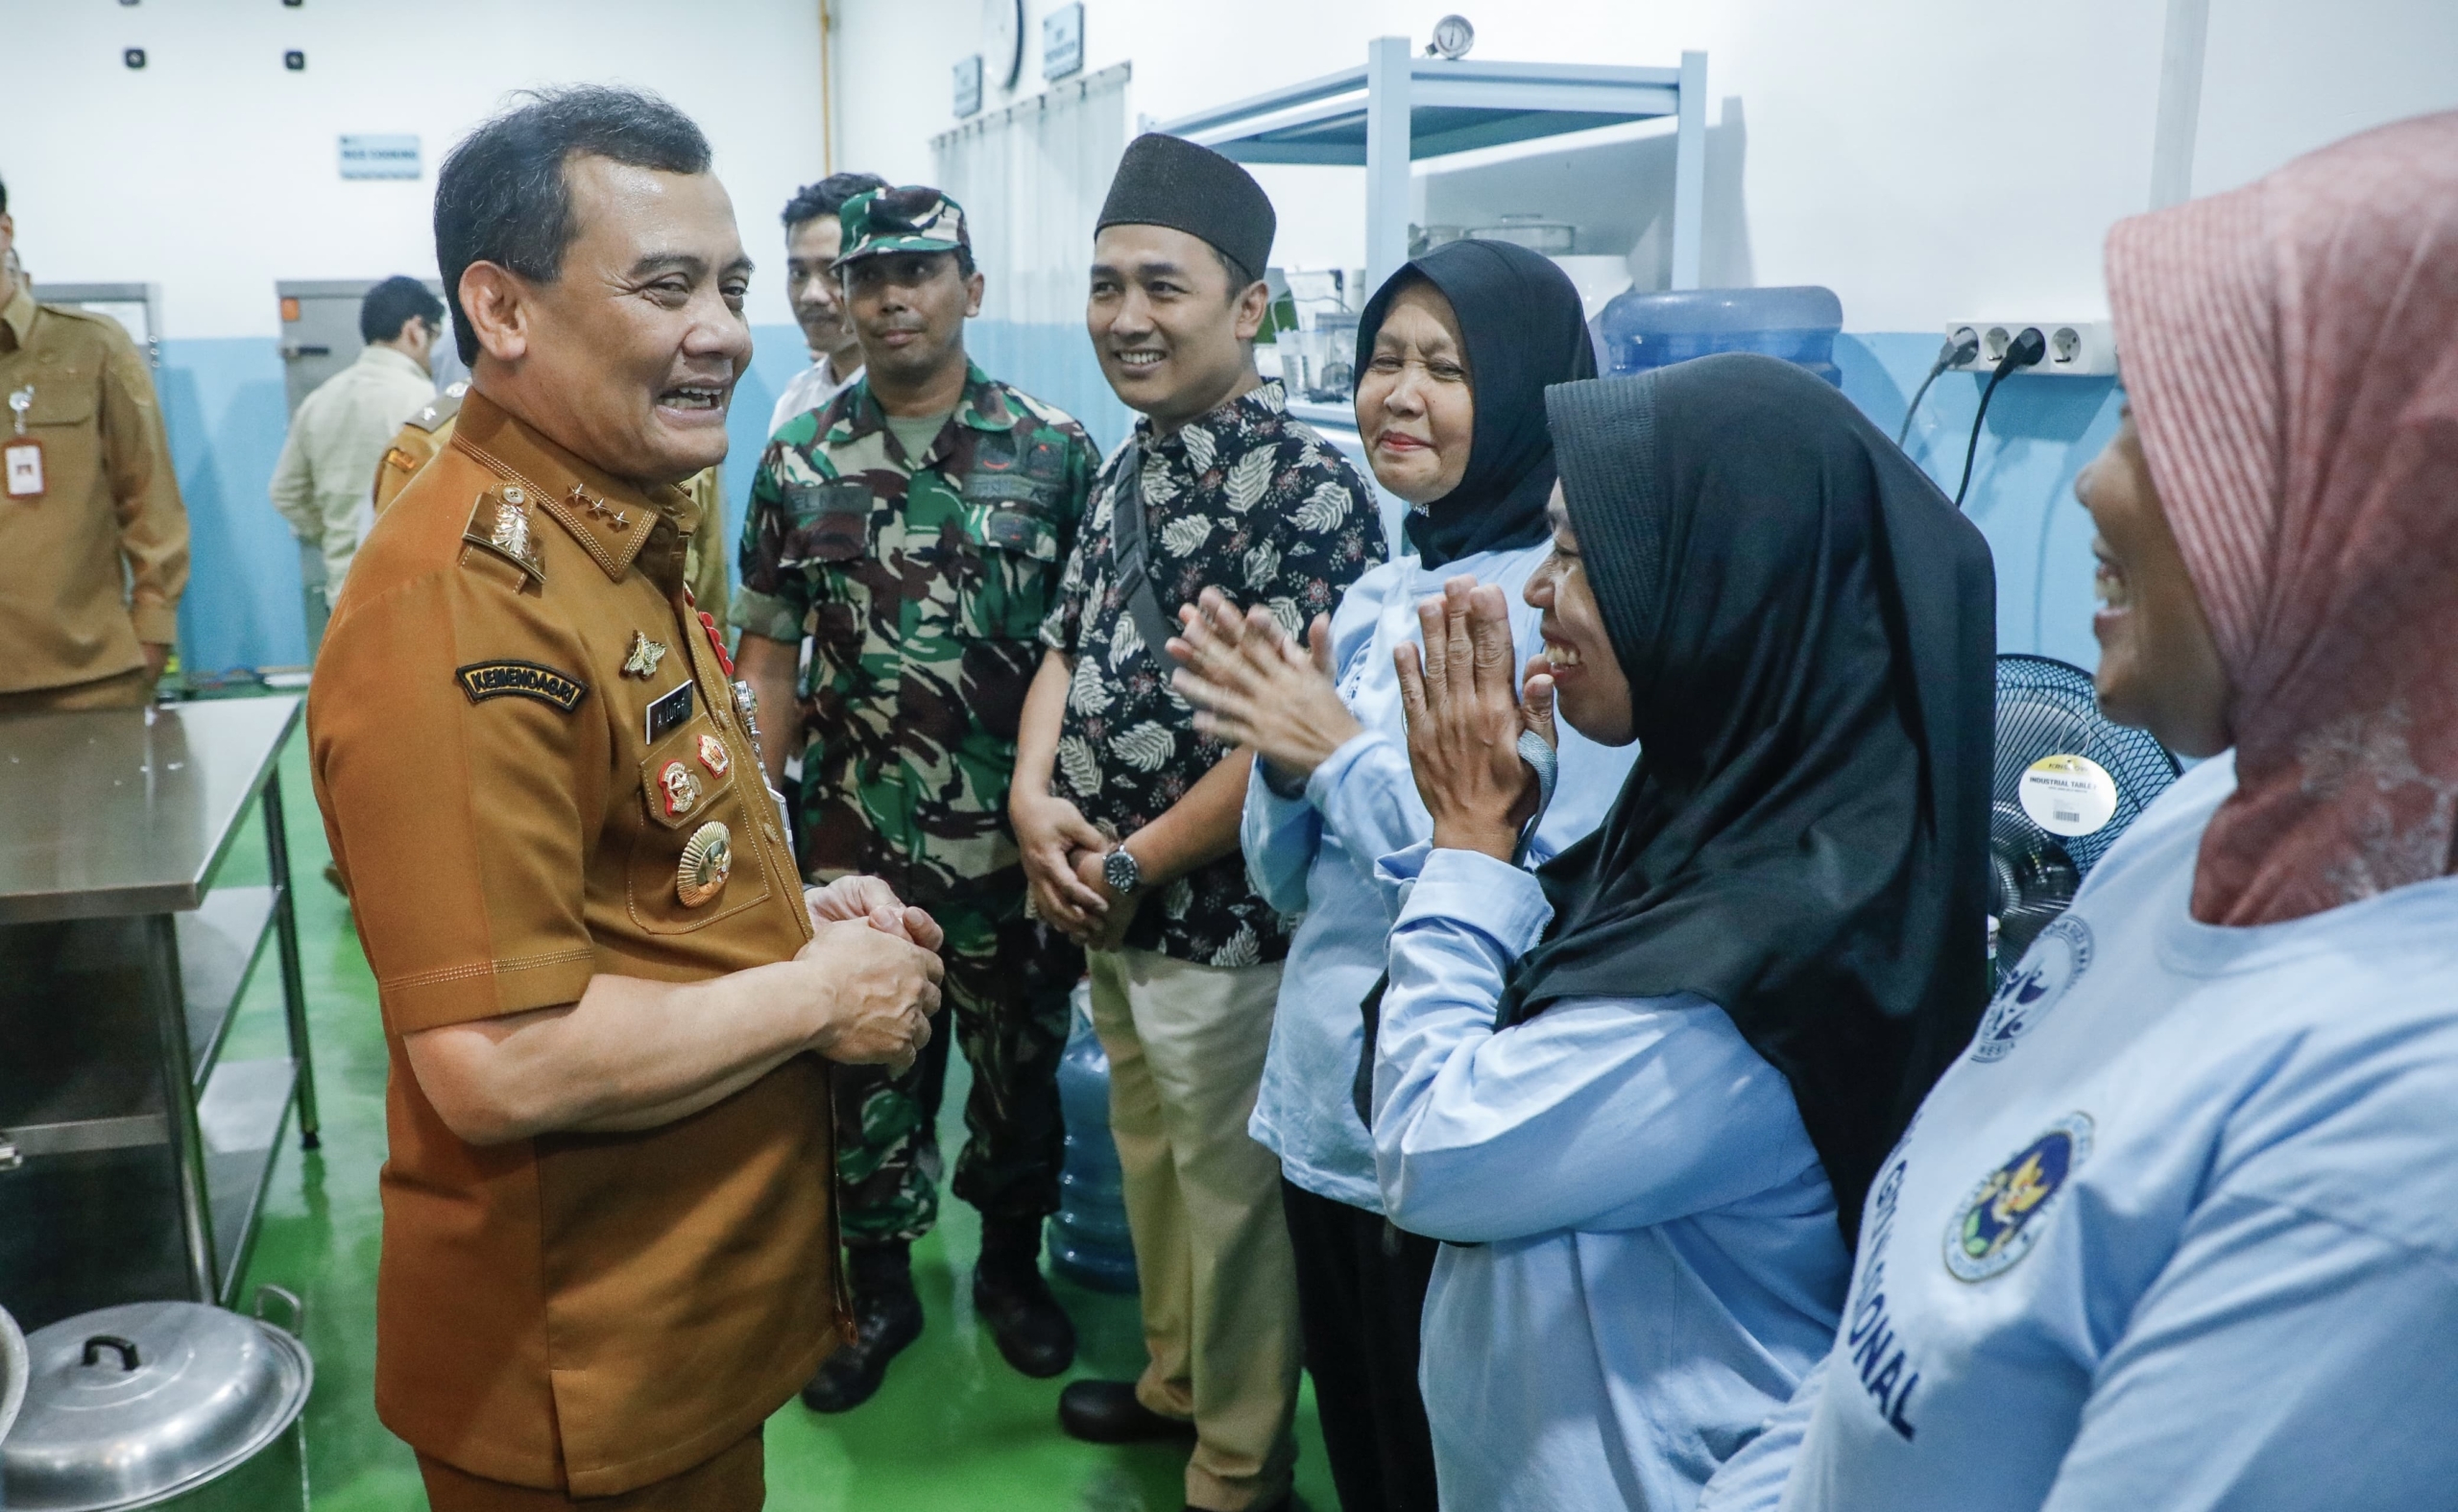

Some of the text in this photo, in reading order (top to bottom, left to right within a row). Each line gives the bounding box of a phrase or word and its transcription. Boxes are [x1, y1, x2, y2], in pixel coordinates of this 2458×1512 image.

[470, 667, 576, 703] KEMENDAGRI
[2030, 776, 2069, 787] INDUSTRIAL
[2071, 780, 2093, 790] TABLE
